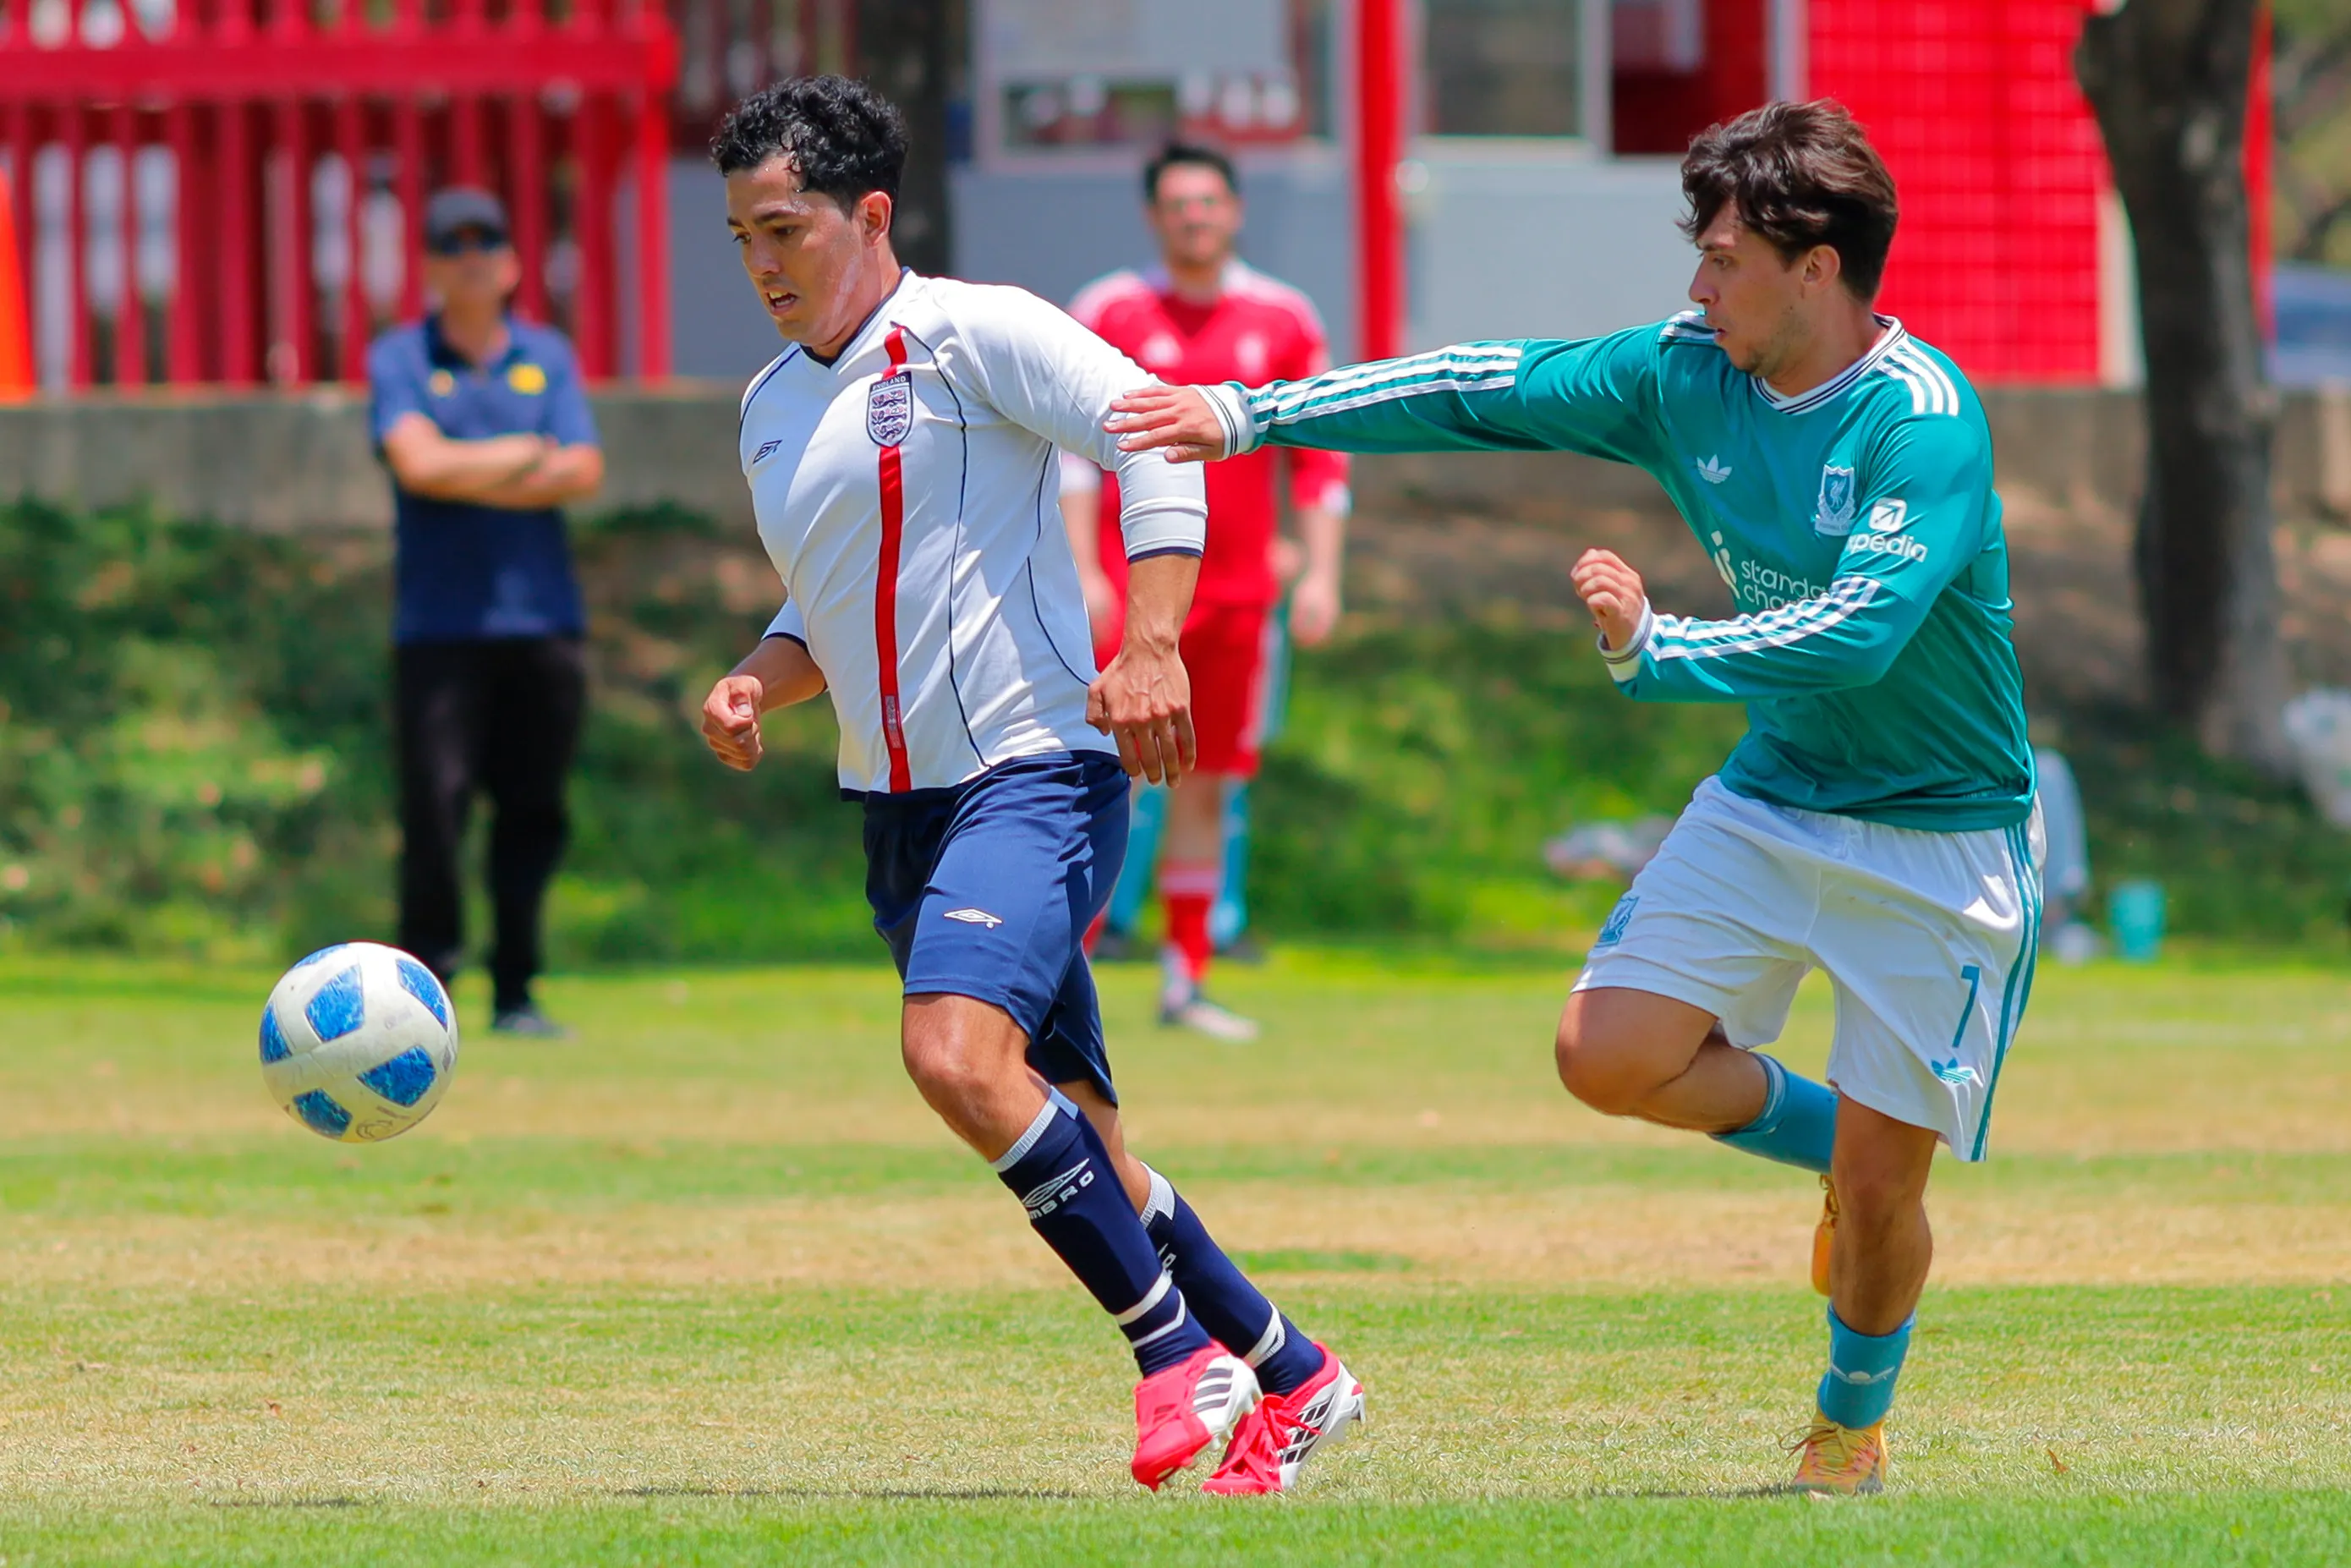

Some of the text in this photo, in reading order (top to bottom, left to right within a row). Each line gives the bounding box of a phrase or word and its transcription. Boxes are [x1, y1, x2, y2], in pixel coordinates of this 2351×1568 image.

[1847, 533, 1929, 563] pedia
[1740, 559, 1827, 600] standa
[1952, 964, 1980, 1048] 7
[1028, 1170, 1095, 1220] MBRO
